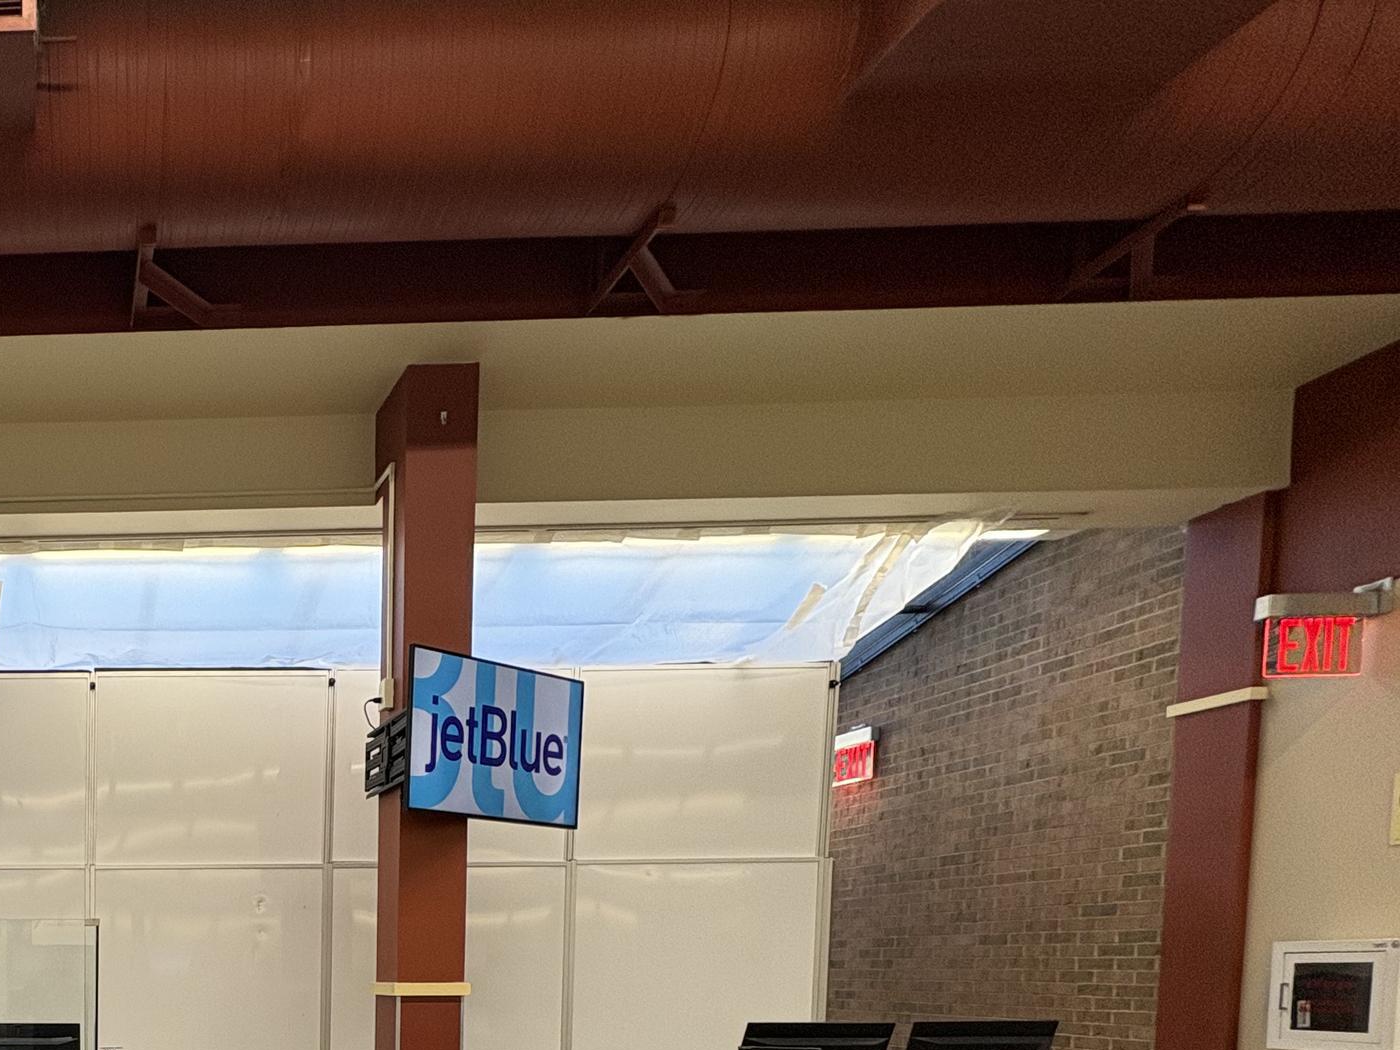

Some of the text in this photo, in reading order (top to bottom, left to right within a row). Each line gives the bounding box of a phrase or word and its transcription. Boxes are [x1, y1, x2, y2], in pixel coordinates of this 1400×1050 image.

[1277, 616, 1357, 673] EXIT
[425, 694, 564, 777] jetBlue
[835, 742, 871, 782] EXIT
